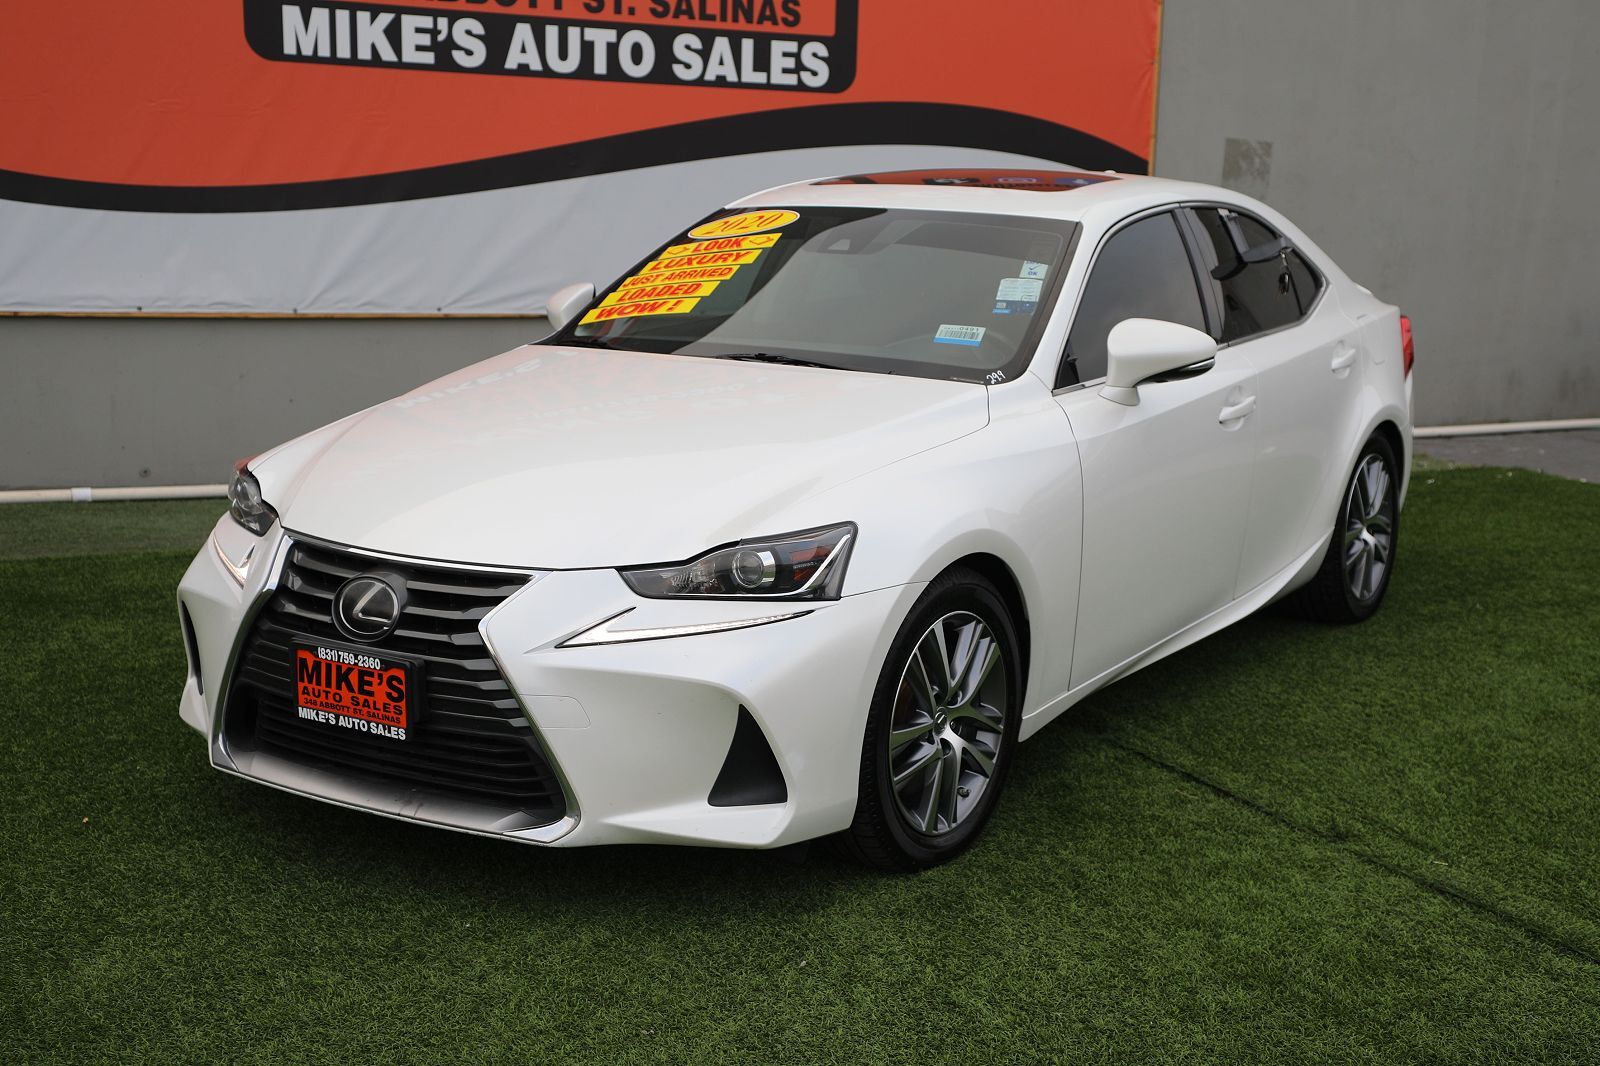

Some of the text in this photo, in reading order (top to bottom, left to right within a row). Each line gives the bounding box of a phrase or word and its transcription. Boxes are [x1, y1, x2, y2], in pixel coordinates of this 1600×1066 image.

[649, 0, 801, 27] SALINAS
[282, 4, 830, 88] MIKE'S AUTO SALES
[703, 213, 784, 235] 2020
[691, 236, 746, 253] LOOK
[649, 250, 752, 272] LUXURY
[622, 266, 734, 288] JUST ARRIVED
[615, 281, 703, 303] LOADED
[594, 301, 667, 321] WOW
[338, 651, 381, 670] 759-2360
[301, 686, 403, 716] AUTO SALES
[303, 697, 401, 724] 348 ABBOTT ST. SALINAS
[338, 716, 368, 732] AUTO
[370, 723, 406, 741] SALES
